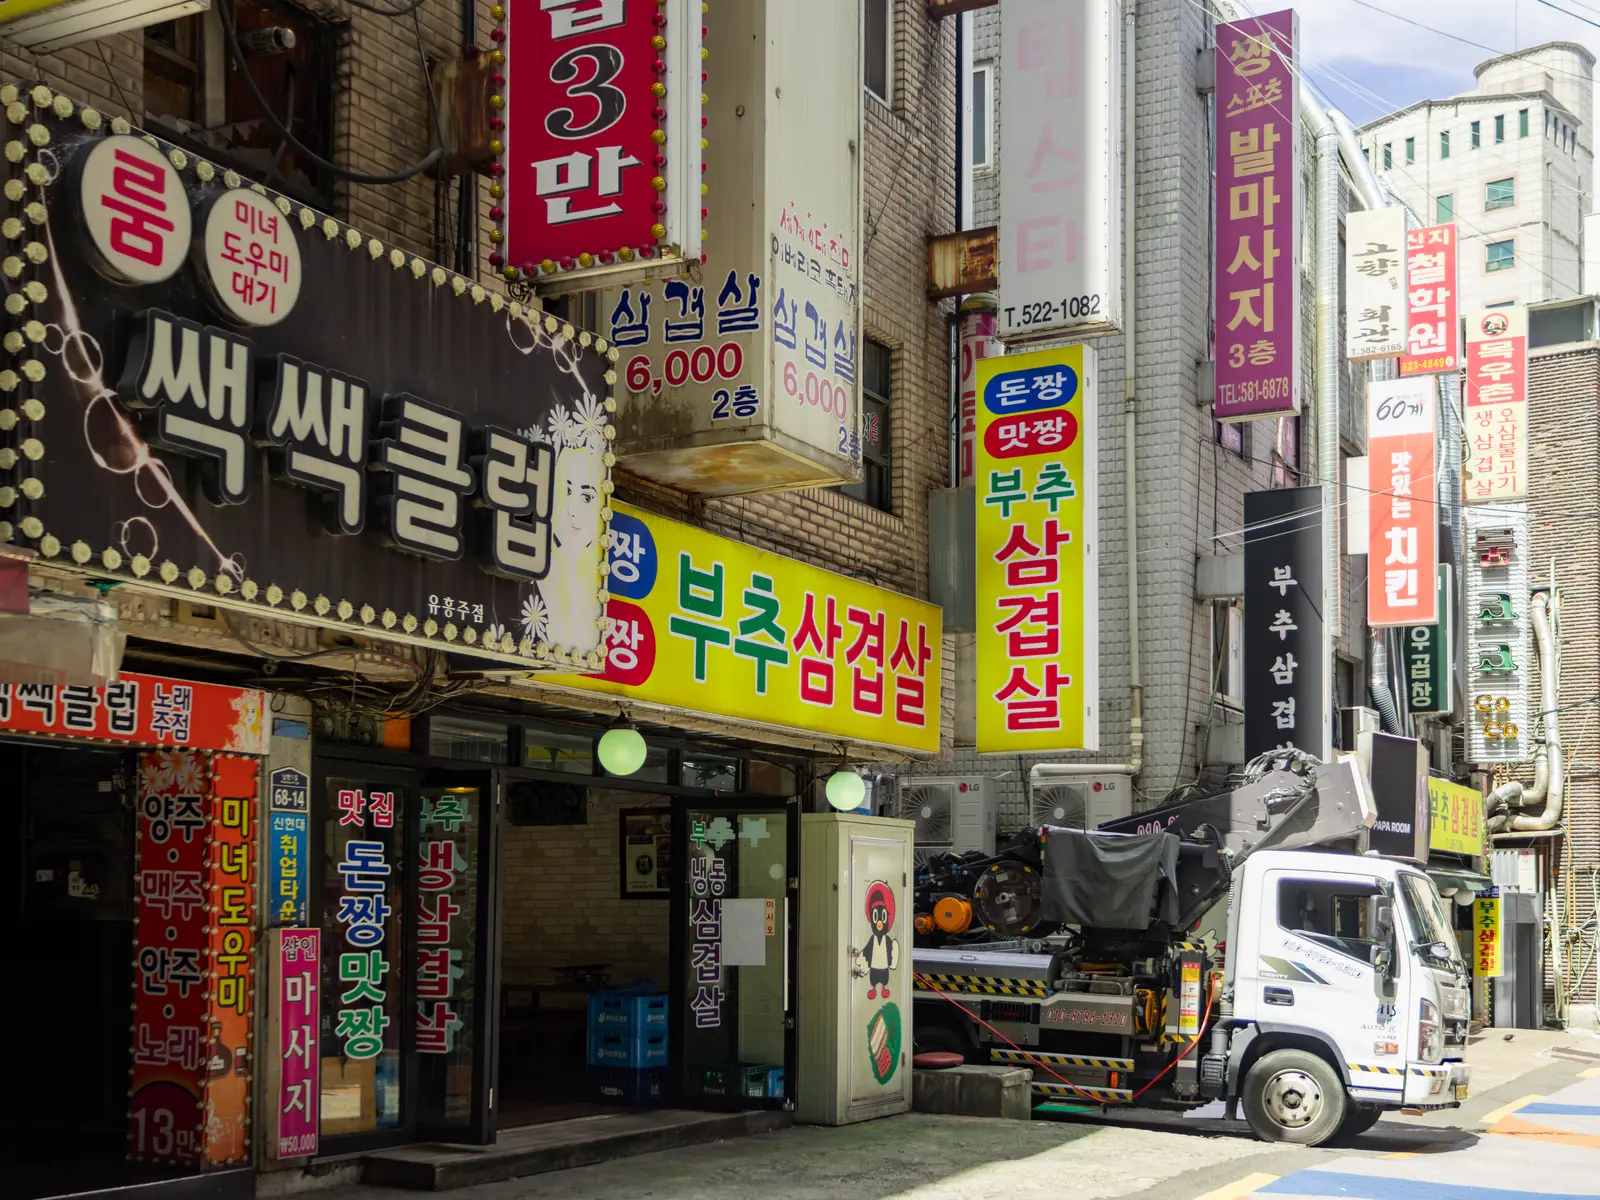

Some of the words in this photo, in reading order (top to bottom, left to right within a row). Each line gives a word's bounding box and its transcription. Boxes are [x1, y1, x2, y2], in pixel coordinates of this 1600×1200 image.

[1230, 31, 1277, 77] 짱
[1225, 78, 1283, 118] 스포츠
[101, 149, 174, 267] 룸
[235, 200, 278, 244] 미녀
[1226, 123, 1281, 333] 발마사지
[221, 232, 289, 283] 도우미
[771, 233, 822, 286] 이베리코
[233, 271, 276, 313] 대기
[611, 269, 761, 347] 삼겹살
[1005, 294, 1101, 329] T.522-1082
[1408, 252, 1450, 356] 철학원
[774, 287, 855, 386] 삼겹살
[1228, 340, 1276, 368] 3층
[626, 343, 743, 395] 6,000
[994, 370, 1069, 408] 돈짱
[1402, 357, 1444, 372] 523-4849
[1478, 340, 1514, 403] 목우촌
[711, 386, 759, 419] 2층
[783, 360, 847, 421] 6,000
[142, 317, 554, 577] 쌕쌕클럽
[997, 414, 1069, 453] 맛짱
[1474, 410, 1494, 496] 생삼겹살
[1497, 407, 1517, 492] 오삼불고기
[984, 463, 1075, 518] 부추
[1391, 451, 1412, 519] 맛있는
[1385, 526, 1418, 607] 치킨
[427, 594, 483, 623] 유흥주점
[992, 519, 1073, 732] 삼겹살
[0, 682, 138, 736] 쌕클럽
[152, 683, 193, 713] 노래
[150, 710, 190, 743] 주점
[275, 788, 305, 806] 68-14
[337, 789, 395, 829] 맛집
[968, 783, 980, 791] LG
[1103, 782, 1116, 791] LG
[144, 795, 205, 843] 양주
[273, 816, 305, 831] 신현대
[420, 796, 464, 831] 추
[1373, 821, 1391, 831] PAPA
[1391, 822, 1411, 834] ROOM
[140, 869, 204, 920] 맥주
[279, 834, 299, 922] 취업타운
[336, 839, 391, 948] 돈짱
[689, 857, 728, 896] 냉동
[216, 797, 250, 1015] 미녀도우미
[766, 900, 774, 934] 미시오
[138, 946, 204, 996] 안주
[689, 899, 726, 1029] 삼겹살
[334, 948, 390, 1060] 맛짱
[134, 1023, 200, 1071] 노래
[282, 971, 316, 1124] 마사지
